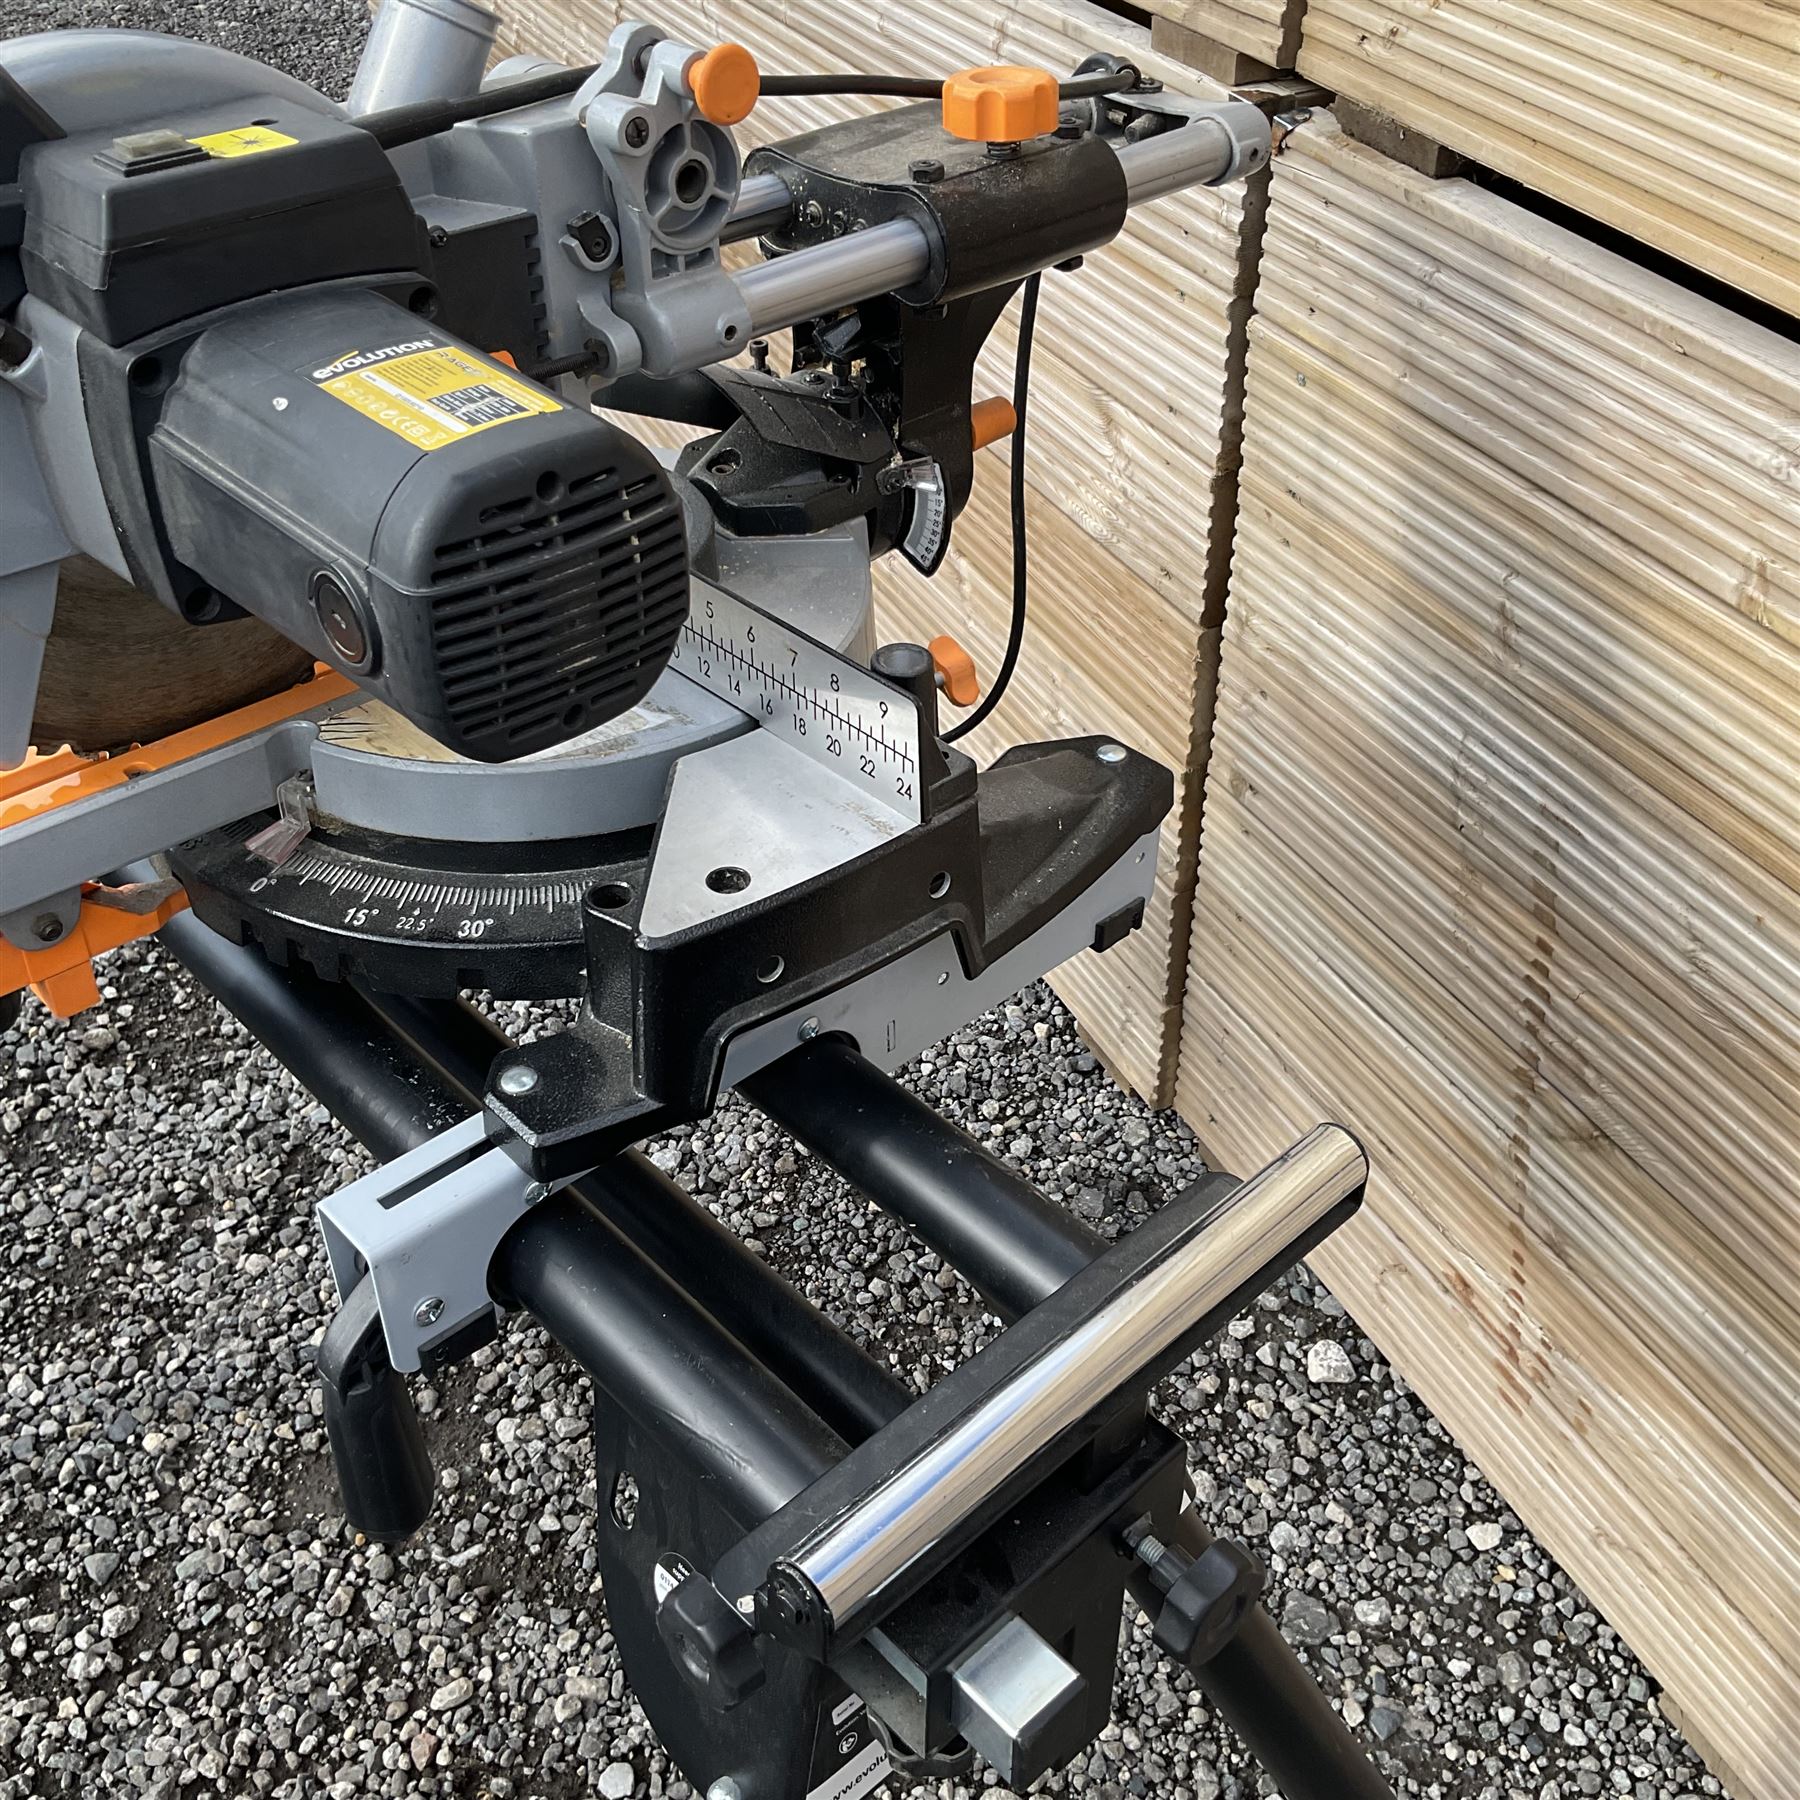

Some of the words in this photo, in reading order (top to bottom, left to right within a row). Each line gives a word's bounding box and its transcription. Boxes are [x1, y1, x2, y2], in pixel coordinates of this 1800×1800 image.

[705, 600, 714, 619] 5
[747, 625, 756, 643] 6
[788, 647, 798, 667] 7
[830, 673, 840, 692] 8
[879, 701, 889, 719] 9
[698, 655, 711, 678] 12
[728, 674, 741, 696] 14
[760, 693, 773, 715] 16
[793, 713, 807, 736] 18
[826, 734, 842, 757] 20
[860, 755, 876, 779] 22
[896, 777, 912, 801] 24
[344, 907, 380, 927] 15°
[457, 918, 496, 938] 30°
